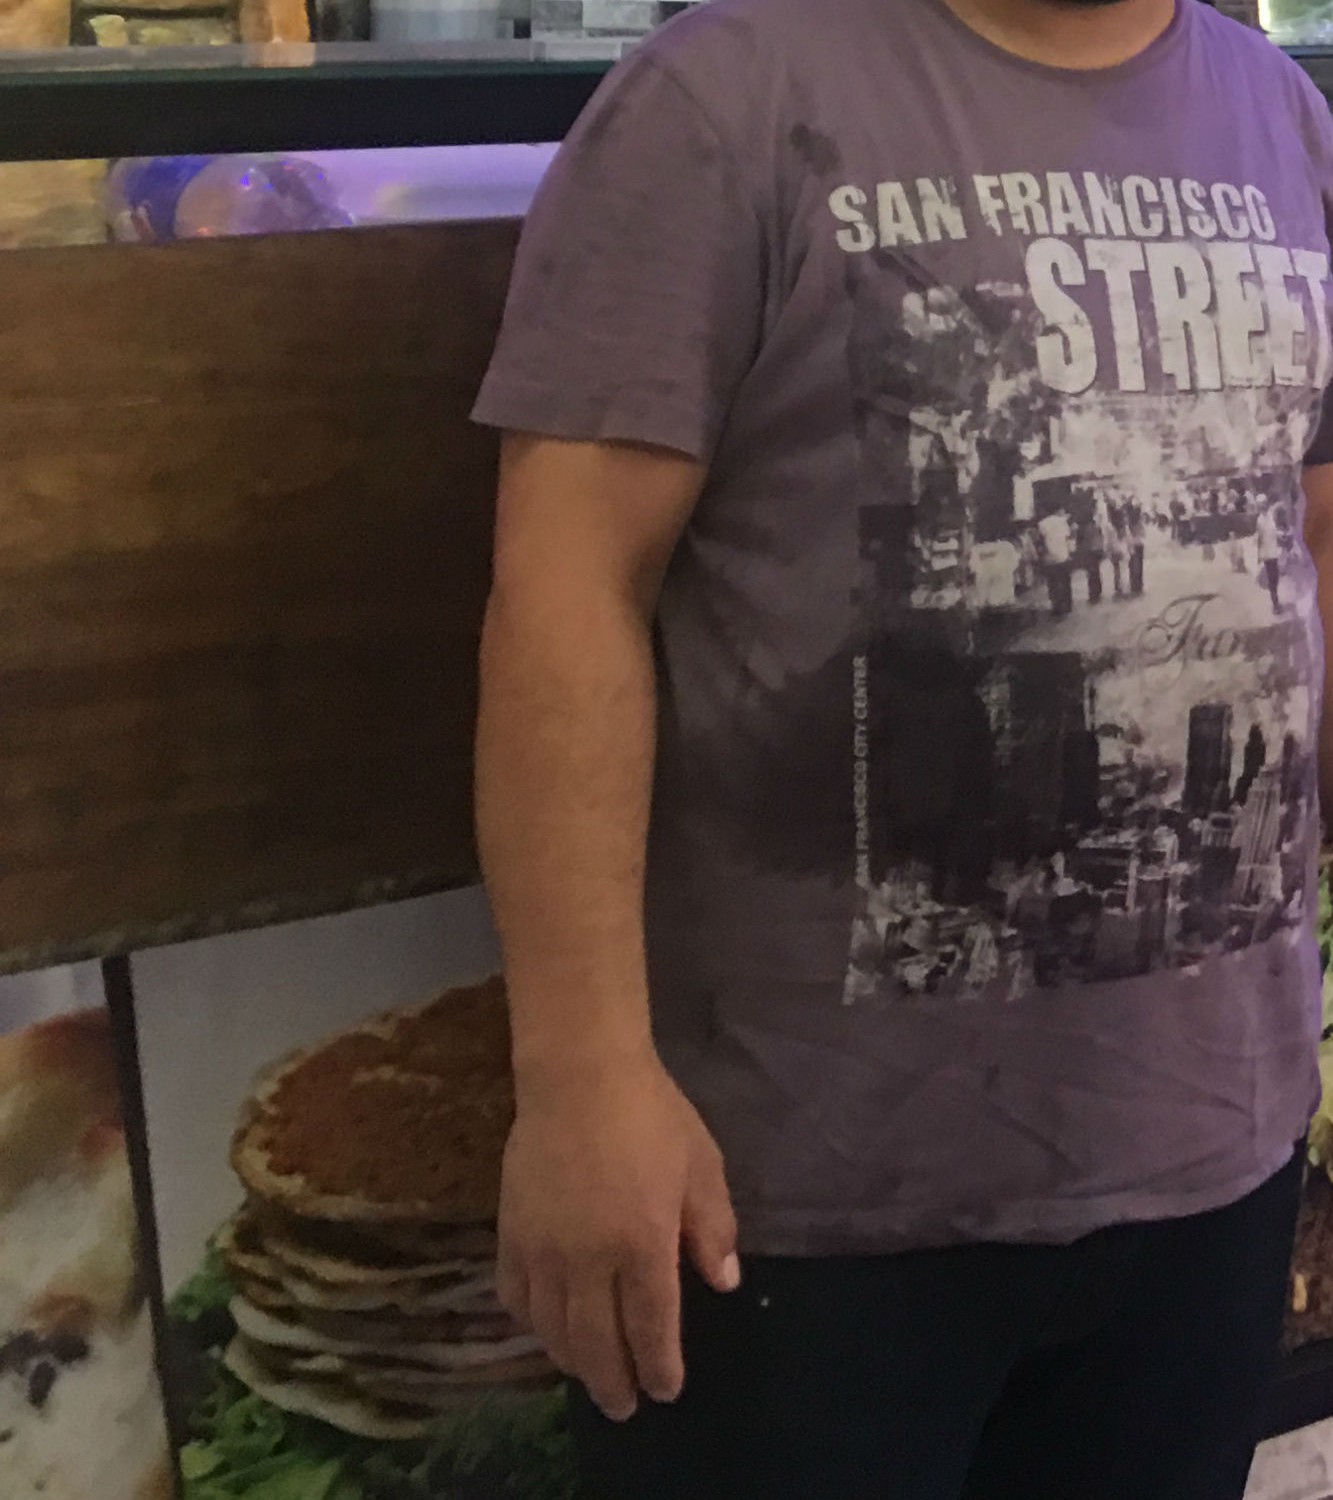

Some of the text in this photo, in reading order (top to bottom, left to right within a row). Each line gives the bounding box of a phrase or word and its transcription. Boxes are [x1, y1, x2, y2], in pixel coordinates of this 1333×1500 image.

[828, 171, 1277, 253] SAN FRANCISCO
[853, 655, 868, 720] CENTER
[853, 723, 868, 758] CITY
